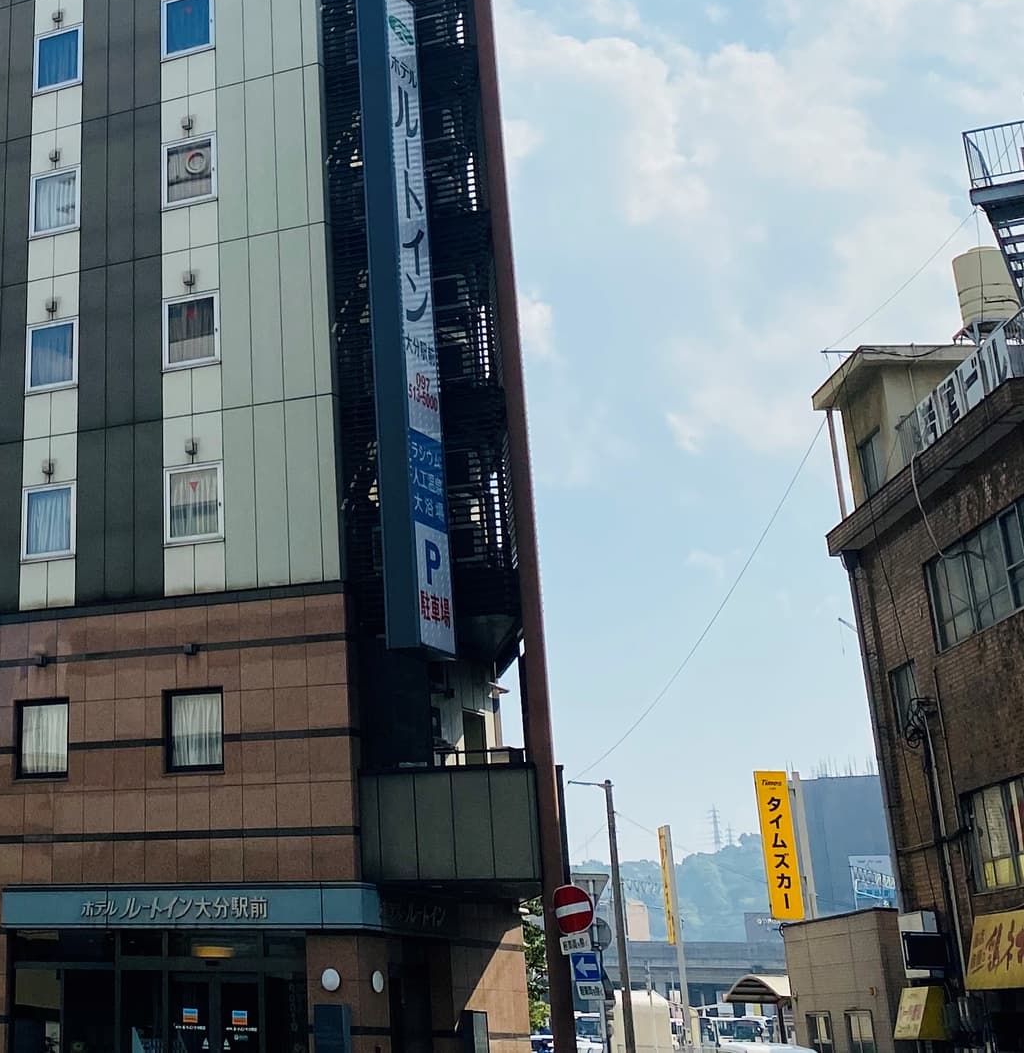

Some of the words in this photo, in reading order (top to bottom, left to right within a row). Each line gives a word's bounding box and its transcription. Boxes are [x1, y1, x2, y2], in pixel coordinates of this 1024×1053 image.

[391, 56, 417, 89] ホテル
[394, 85, 428, 323] ルートイン
[425, 539, 441, 586] P
[420, 590, 451, 628] 駐車場
[767, 796, 792, 909] タイムズカー
[80, 899, 119, 918] ホテル
